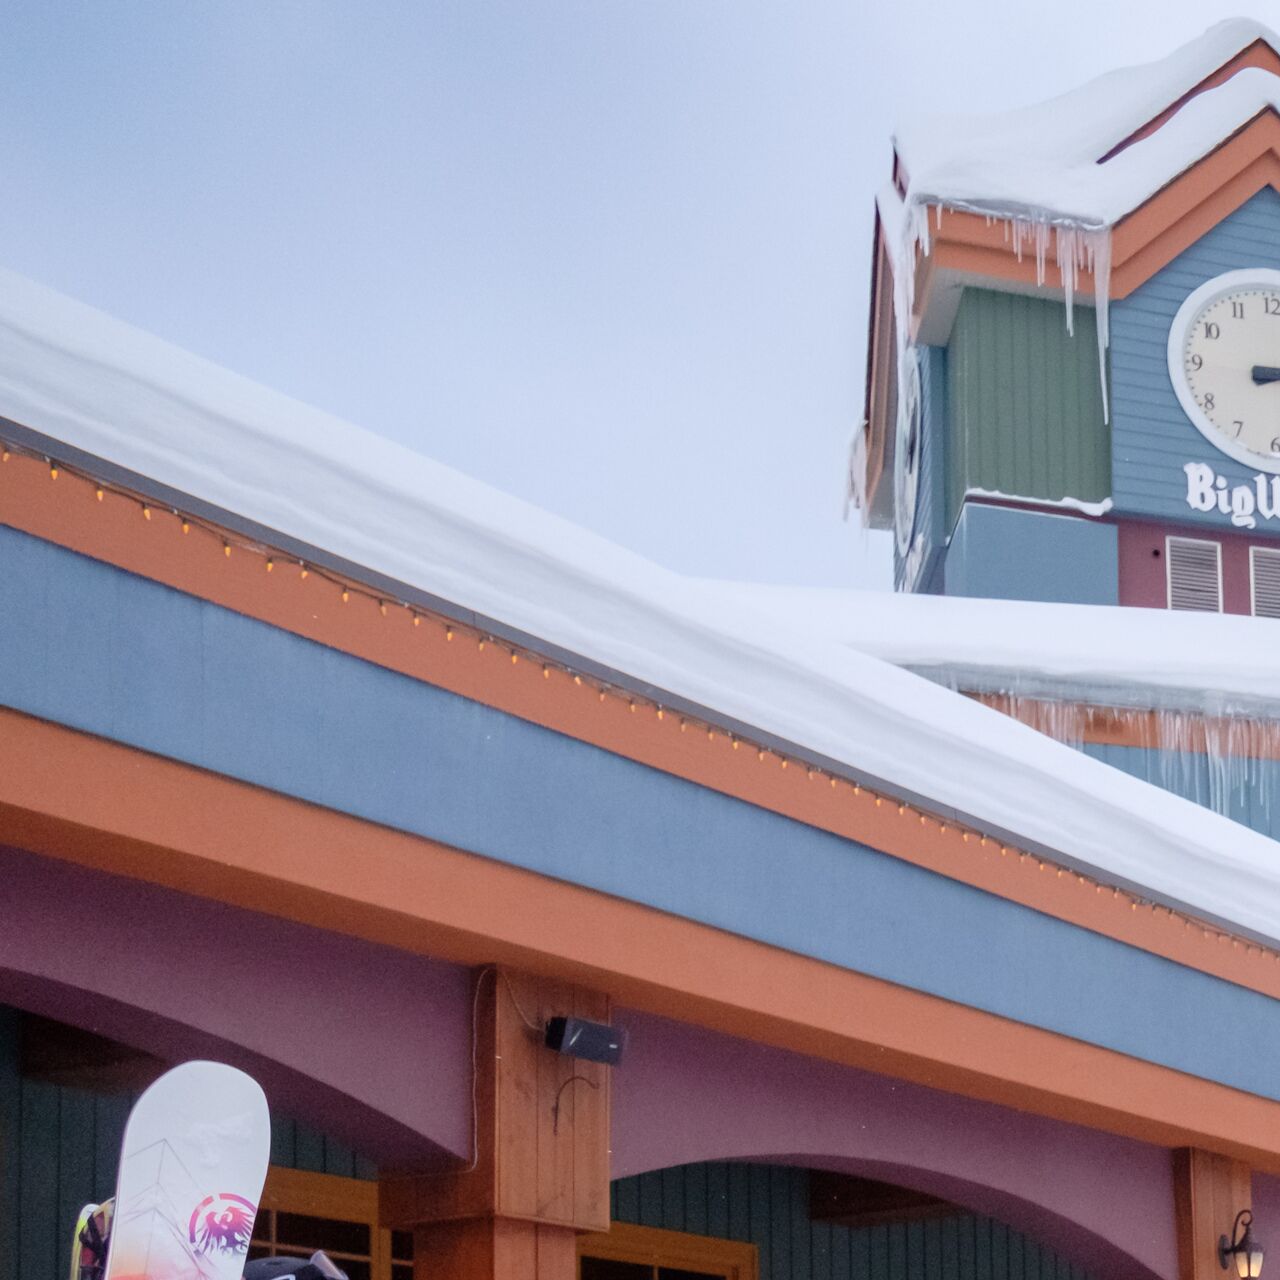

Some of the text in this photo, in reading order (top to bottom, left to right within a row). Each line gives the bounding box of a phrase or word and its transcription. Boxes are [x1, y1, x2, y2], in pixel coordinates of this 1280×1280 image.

[1231, 301, 1245, 320] 11
[1203, 322, 1221, 340] 10
[1190, 354, 1203, 371] 9
[1203, 393, 1215, 411] 8
[1231, 421, 1244, 439] 7
